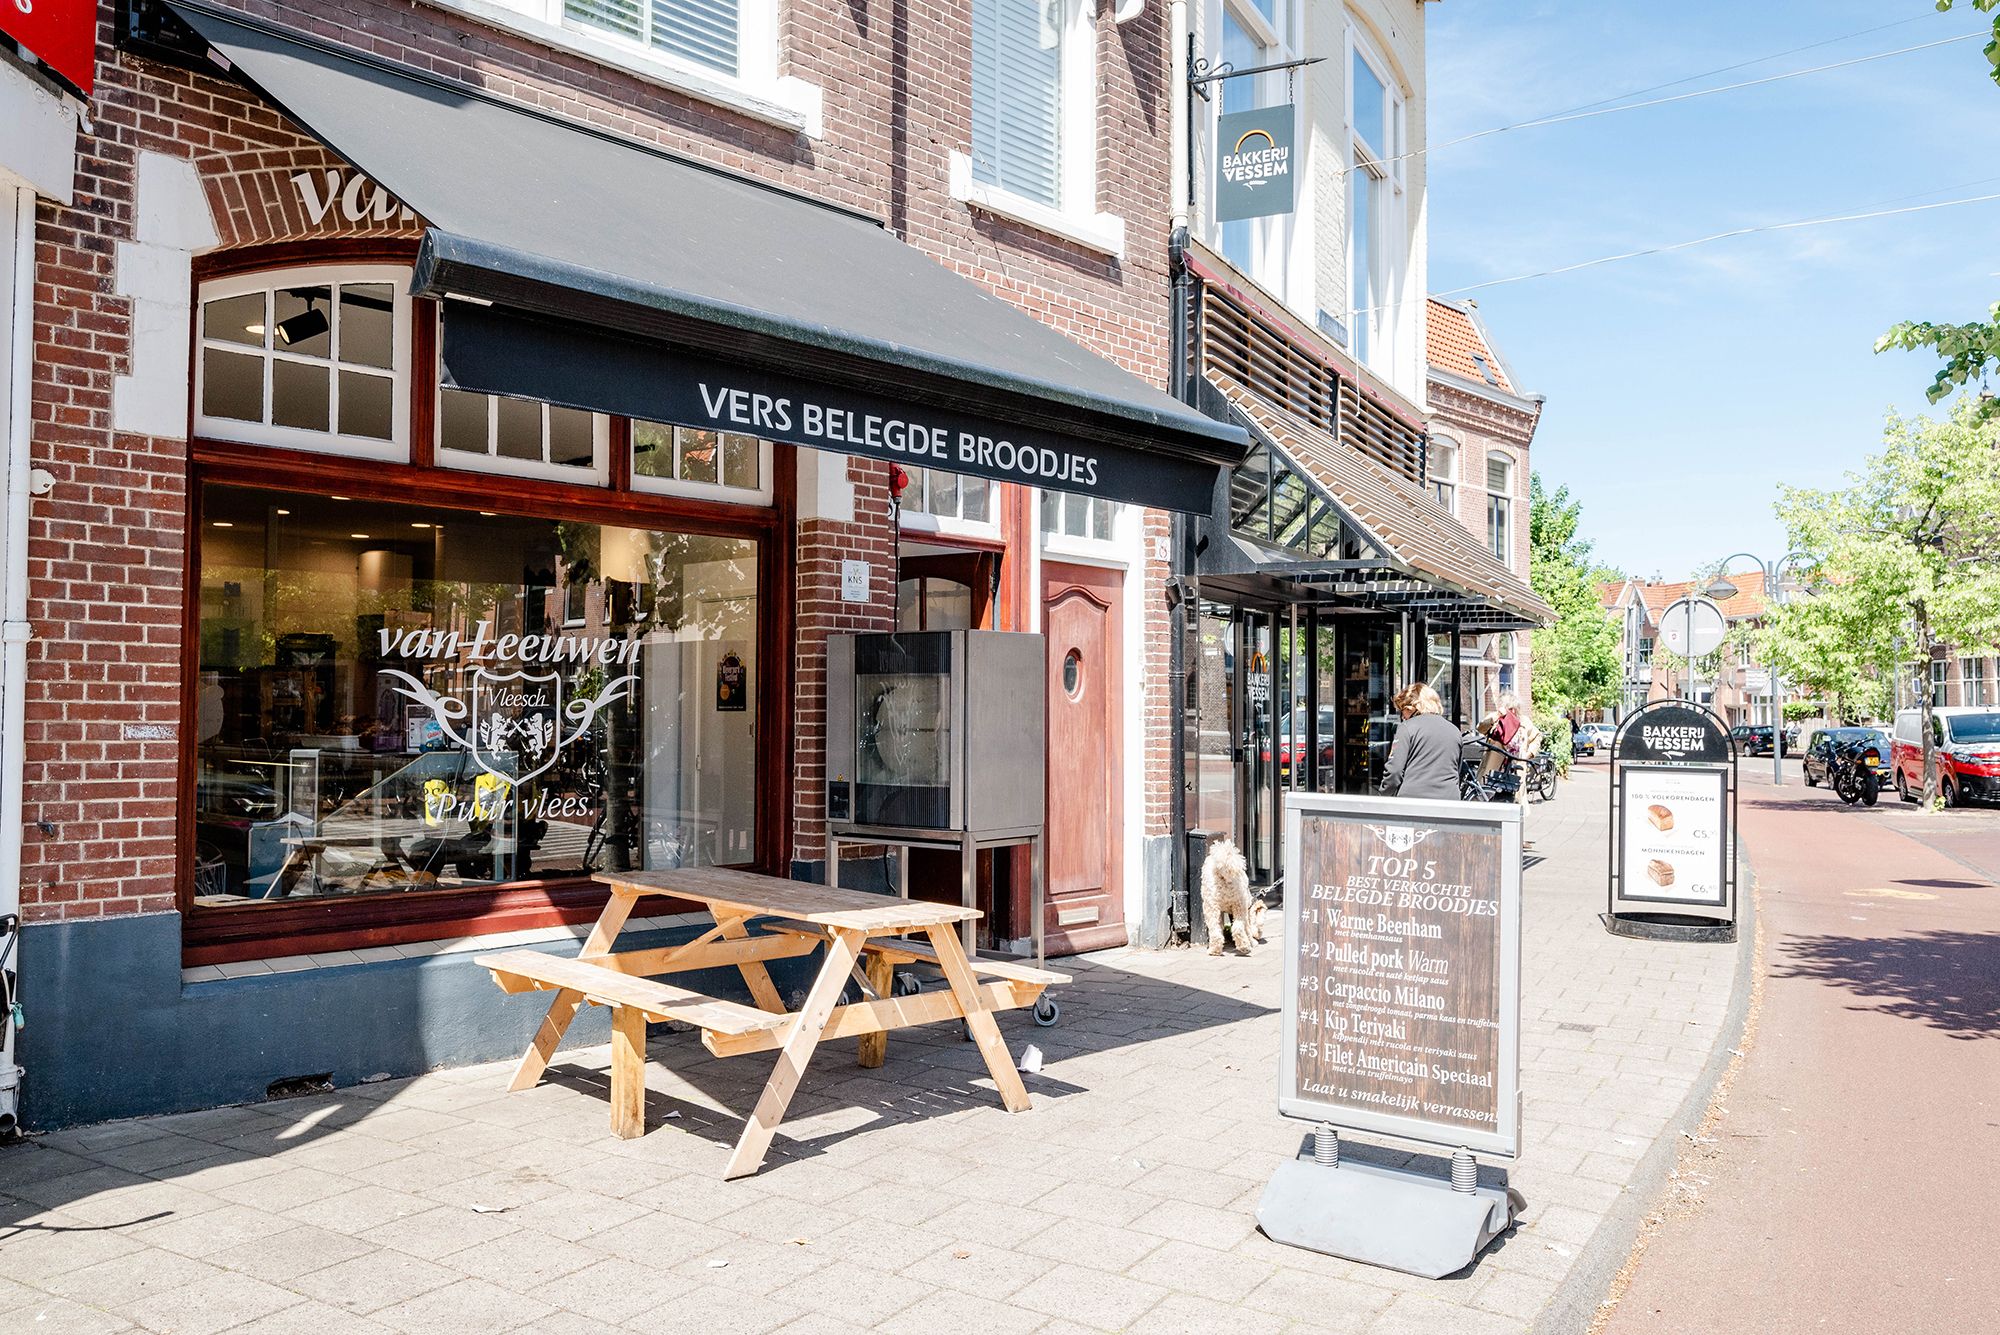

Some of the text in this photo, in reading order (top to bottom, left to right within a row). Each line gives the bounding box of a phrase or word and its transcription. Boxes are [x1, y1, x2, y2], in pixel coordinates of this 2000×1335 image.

[1223, 146, 1289, 168] BAKKERIJ
[1223, 161, 1288, 183] VESSEM
[290, 170, 415, 226] va
[699, 382, 1098, 486] VERS BELEGDE BROODJES
[847, 575, 863, 584] KNS
[377, 620, 641, 665] van Leeuwen
[489, 688, 550, 708] Vleesch
[1643, 725, 1705, 739] BAKKERIJ
[1643, 737, 1705, 751] VESSEM
[435, 787, 595, 824] Puur vlees.
[1367, 855, 1438, 880] TOP 5
[1346, 875, 1472, 898] BEST VERKOCHTE
[1311, 884, 1499, 917] BELEGDE BROODJES
[1300, 908, 1442, 939] #1 Warme Beenham
[1334, 929, 1403, 943] met beenhamsaus
[1300, 941, 1449, 974] #2 Pulled pork Warm
[1333, 965, 1349, 974] met
[1375, 970, 1385, 978] en
[1404, 973, 1429, 985] ketjap
[1430, 977, 1449, 986] saus
[1299, 975, 1445, 1011] #3 Carpaccio Milano
[1332, 1000, 1345, 1008] met
[1299, 1008, 1406, 1041] #4 Kip Teriyaki
[1370, 1039, 1385, 1048] met
[1386, 1041, 1412, 1052] rucola
[1424, 1046, 1457, 1059] teriyaki
[1458, 1052, 1477, 1061] saus
[1299, 1041, 1492, 1088] #5 Filet Americain Speciaal
[1332, 1064, 1347, 1073] met
[1367, 1068, 1414, 1084] truffelmayo
[1303, 1078, 1335, 1096] Laat
[1338, 1087, 1348, 1098] u
[1350, 1088, 1420, 1112] smakelijk
